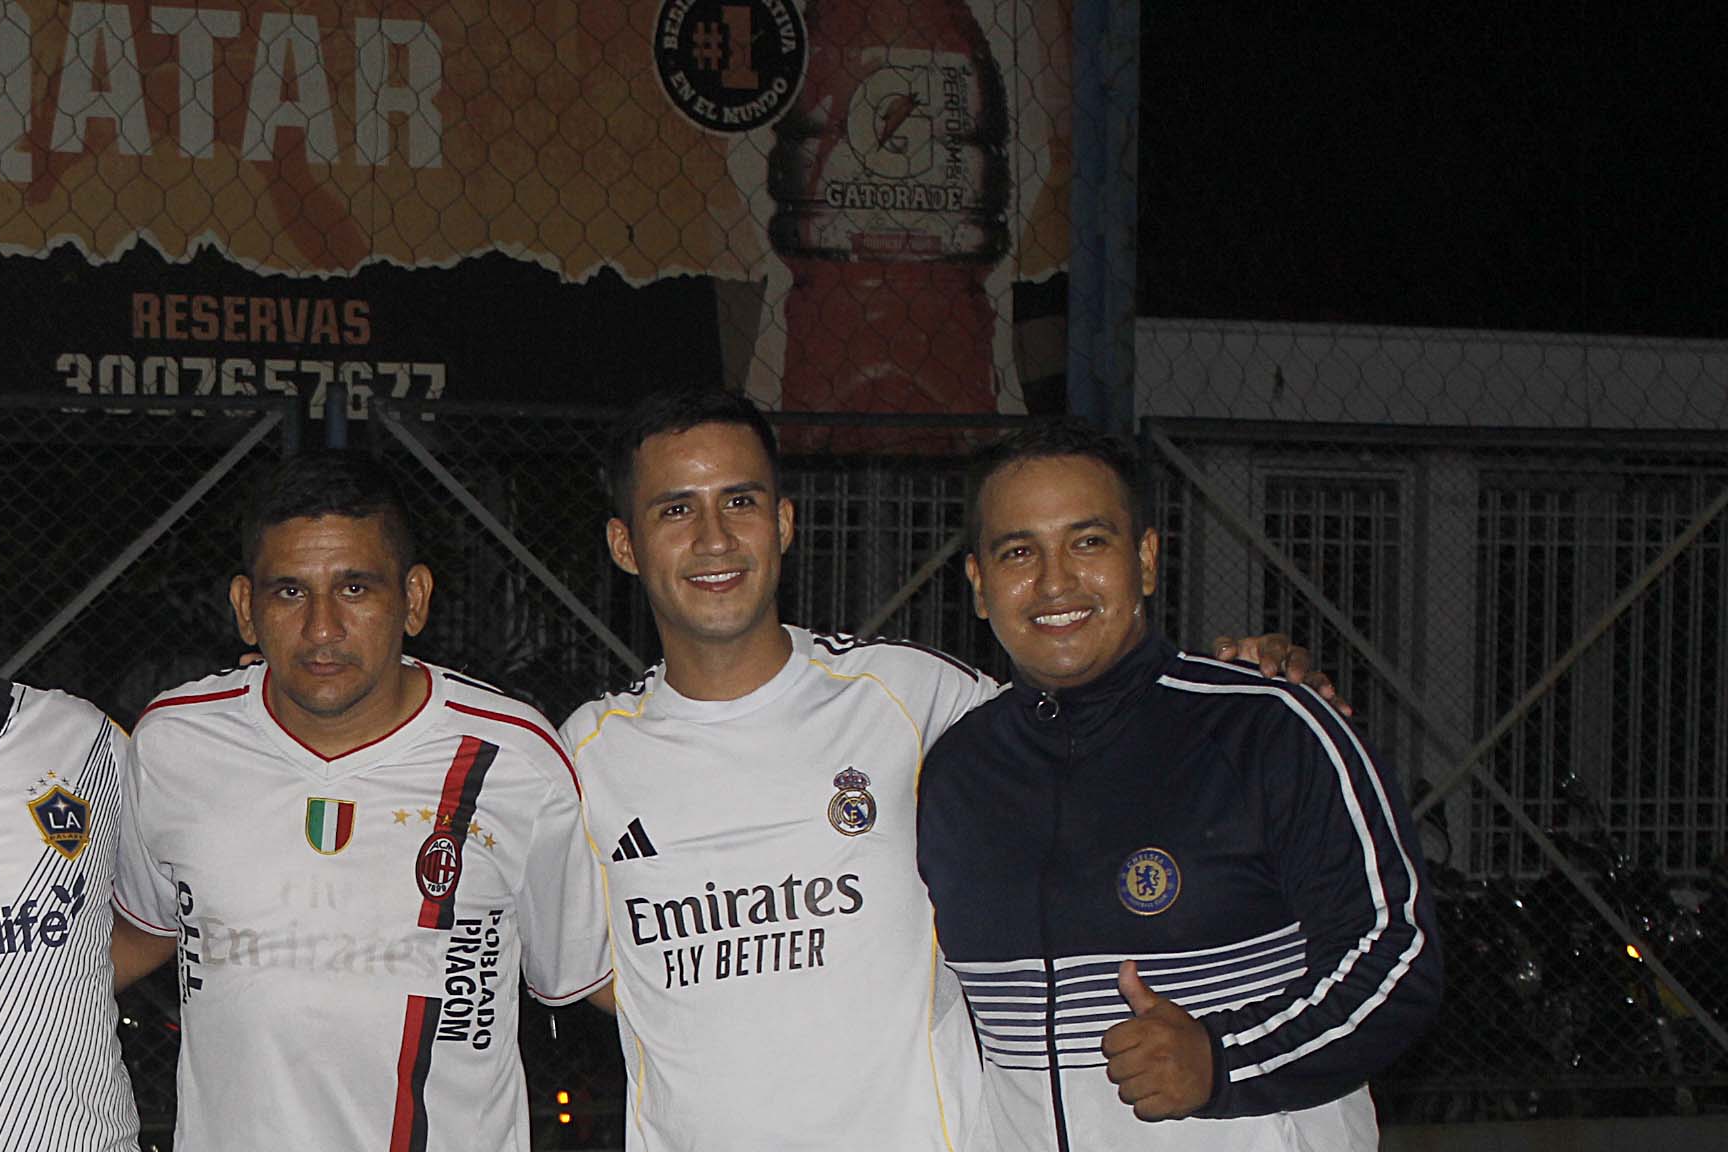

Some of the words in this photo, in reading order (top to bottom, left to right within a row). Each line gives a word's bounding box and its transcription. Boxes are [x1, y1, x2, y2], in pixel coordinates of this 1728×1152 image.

[692, 4, 760, 90] #1
[669, 70, 697, 102] EN
[692, 95, 720, 121] EL
[721, 77, 790, 125] MUNDO
[824, 181, 962, 212] GATORADE
[132, 292, 372, 345] RESERVAS
[56, 353, 448, 421] 3007657677
[47, 811, 82, 830] LA
[429, 839, 454, 854] ACM
[427, 883, 447, 893] 1899
[626, 873, 864, 946] Emirates
[436, 919, 483, 1043] PRAGOM
[472, 909, 504, 1051] POBLADO
[664, 946, 705, 989] FLY
[715, 928, 826, 980] BETTER
